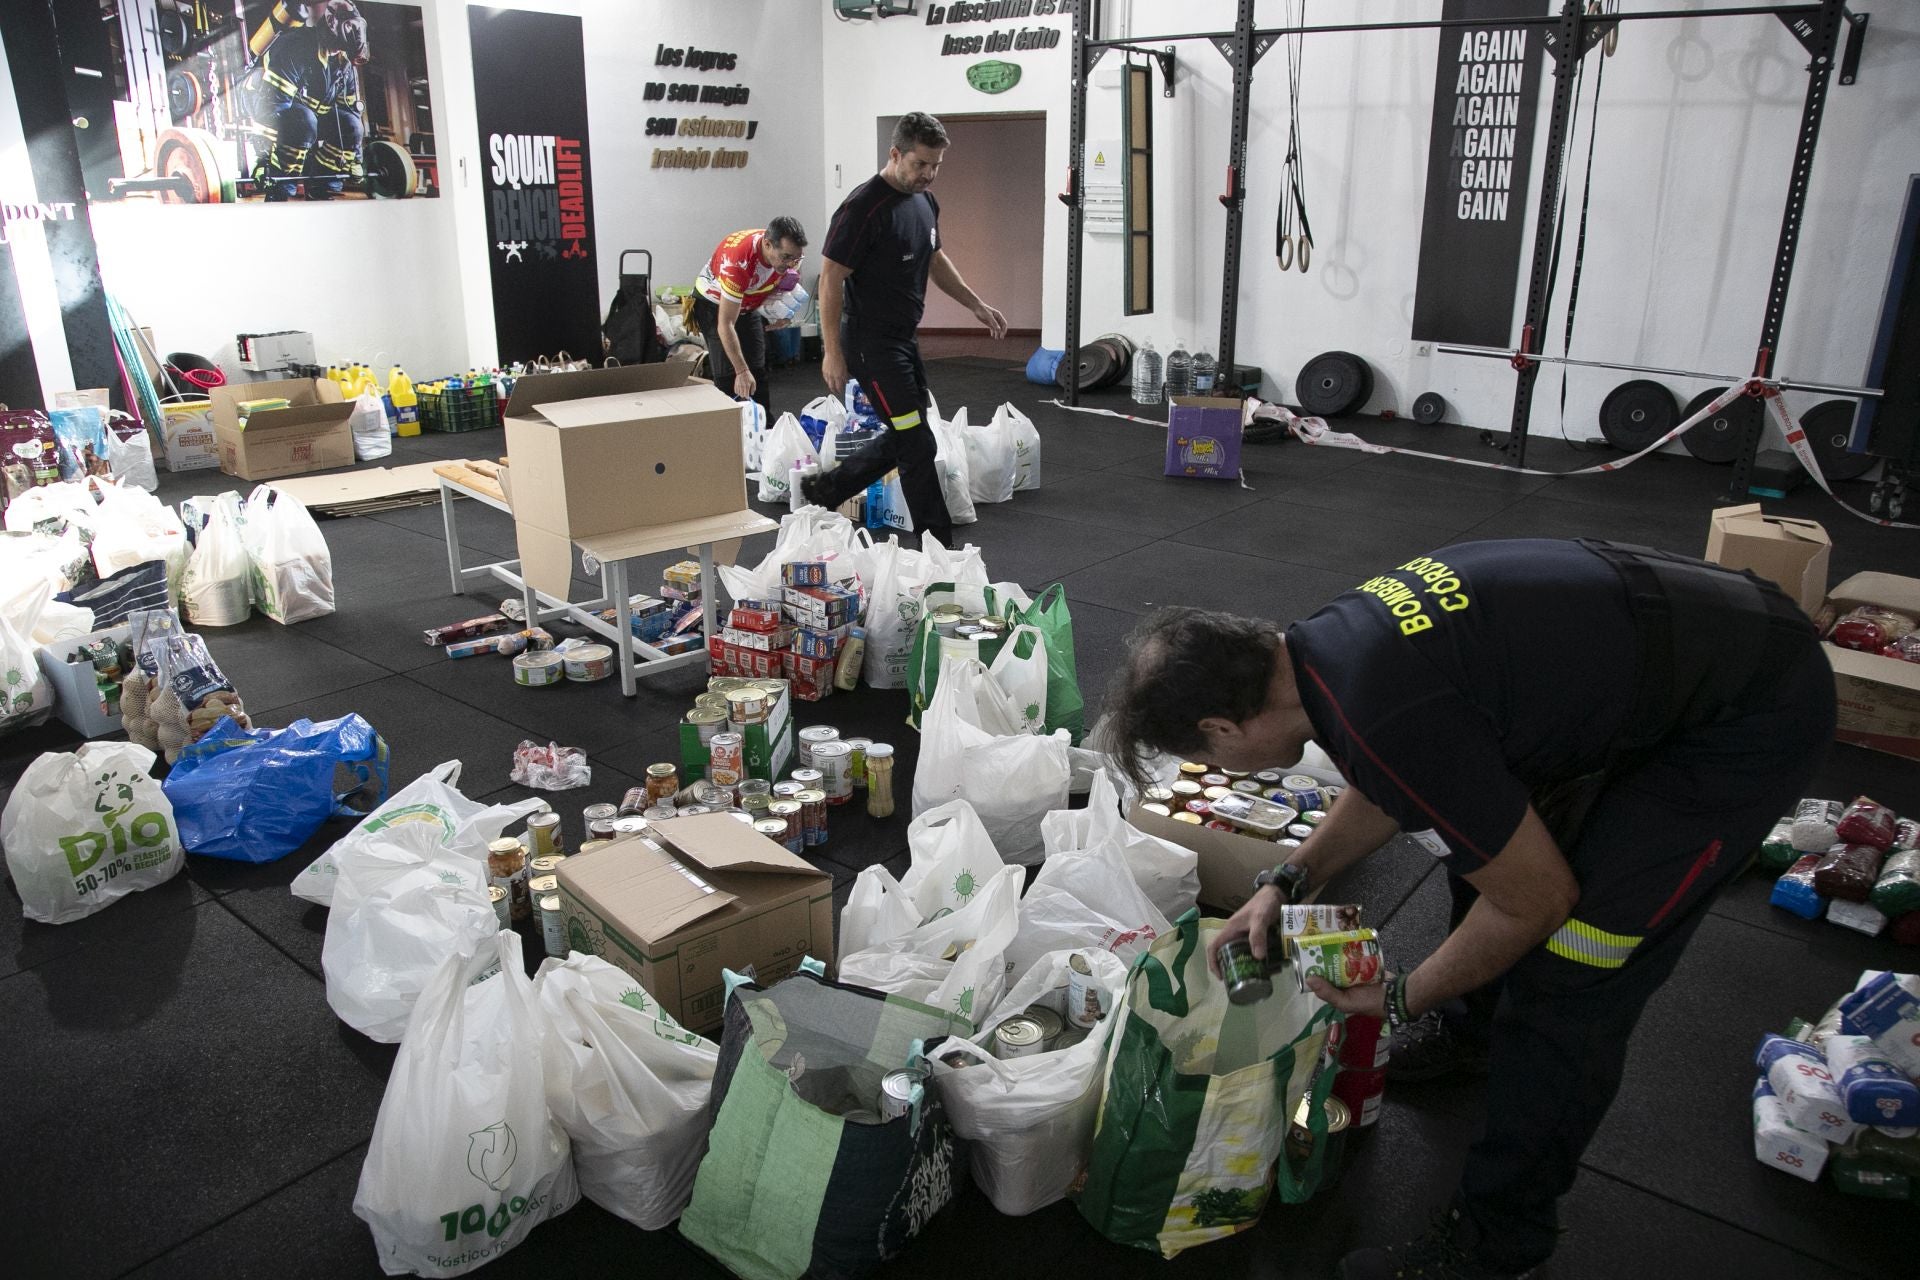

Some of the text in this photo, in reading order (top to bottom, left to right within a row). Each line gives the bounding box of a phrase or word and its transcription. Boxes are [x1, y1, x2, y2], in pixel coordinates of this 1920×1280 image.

[926, 4, 946, 25] La
[946, 0, 1032, 23] disciplina
[1033, 0, 1056, 15] es
[941, 26, 1061, 56] base del éxito
[1793, 18, 1814, 38] AFW
[655, 43, 738, 72] Los logros
[1458, 29, 1527, 62] AGAIN
[1455, 63, 1524, 95] AGAIN
[643, 82, 750, 107] no son magia
[1452, 96, 1520, 127] AGAIN
[645, 115, 759, 140] son esfuerzo y
[650, 146, 749, 170] trabajo duro
[1449, 128, 1517, 159] AGAIN
[489, 133, 556, 190] SQUAT
[1237, 140, 1248, 212] AlleeWeight
[556, 136, 587, 239] DEADLIFT
[5, 202, 76, 221] DON'T
[491, 188, 562, 241] BENCH
[1457, 191, 1509, 221] GAIN
[884, 508, 905, 525] Cien
[1396, 557, 1469, 611] CÓRDO
[1355, 576, 1433, 635] BOMBER
[75, 857, 132, 896] 50-70%
[1797, 1064, 1833, 1081] SO
[1819, 1111, 1846, 1128] SOS
[1776, 1151, 1805, 1169] SOS
